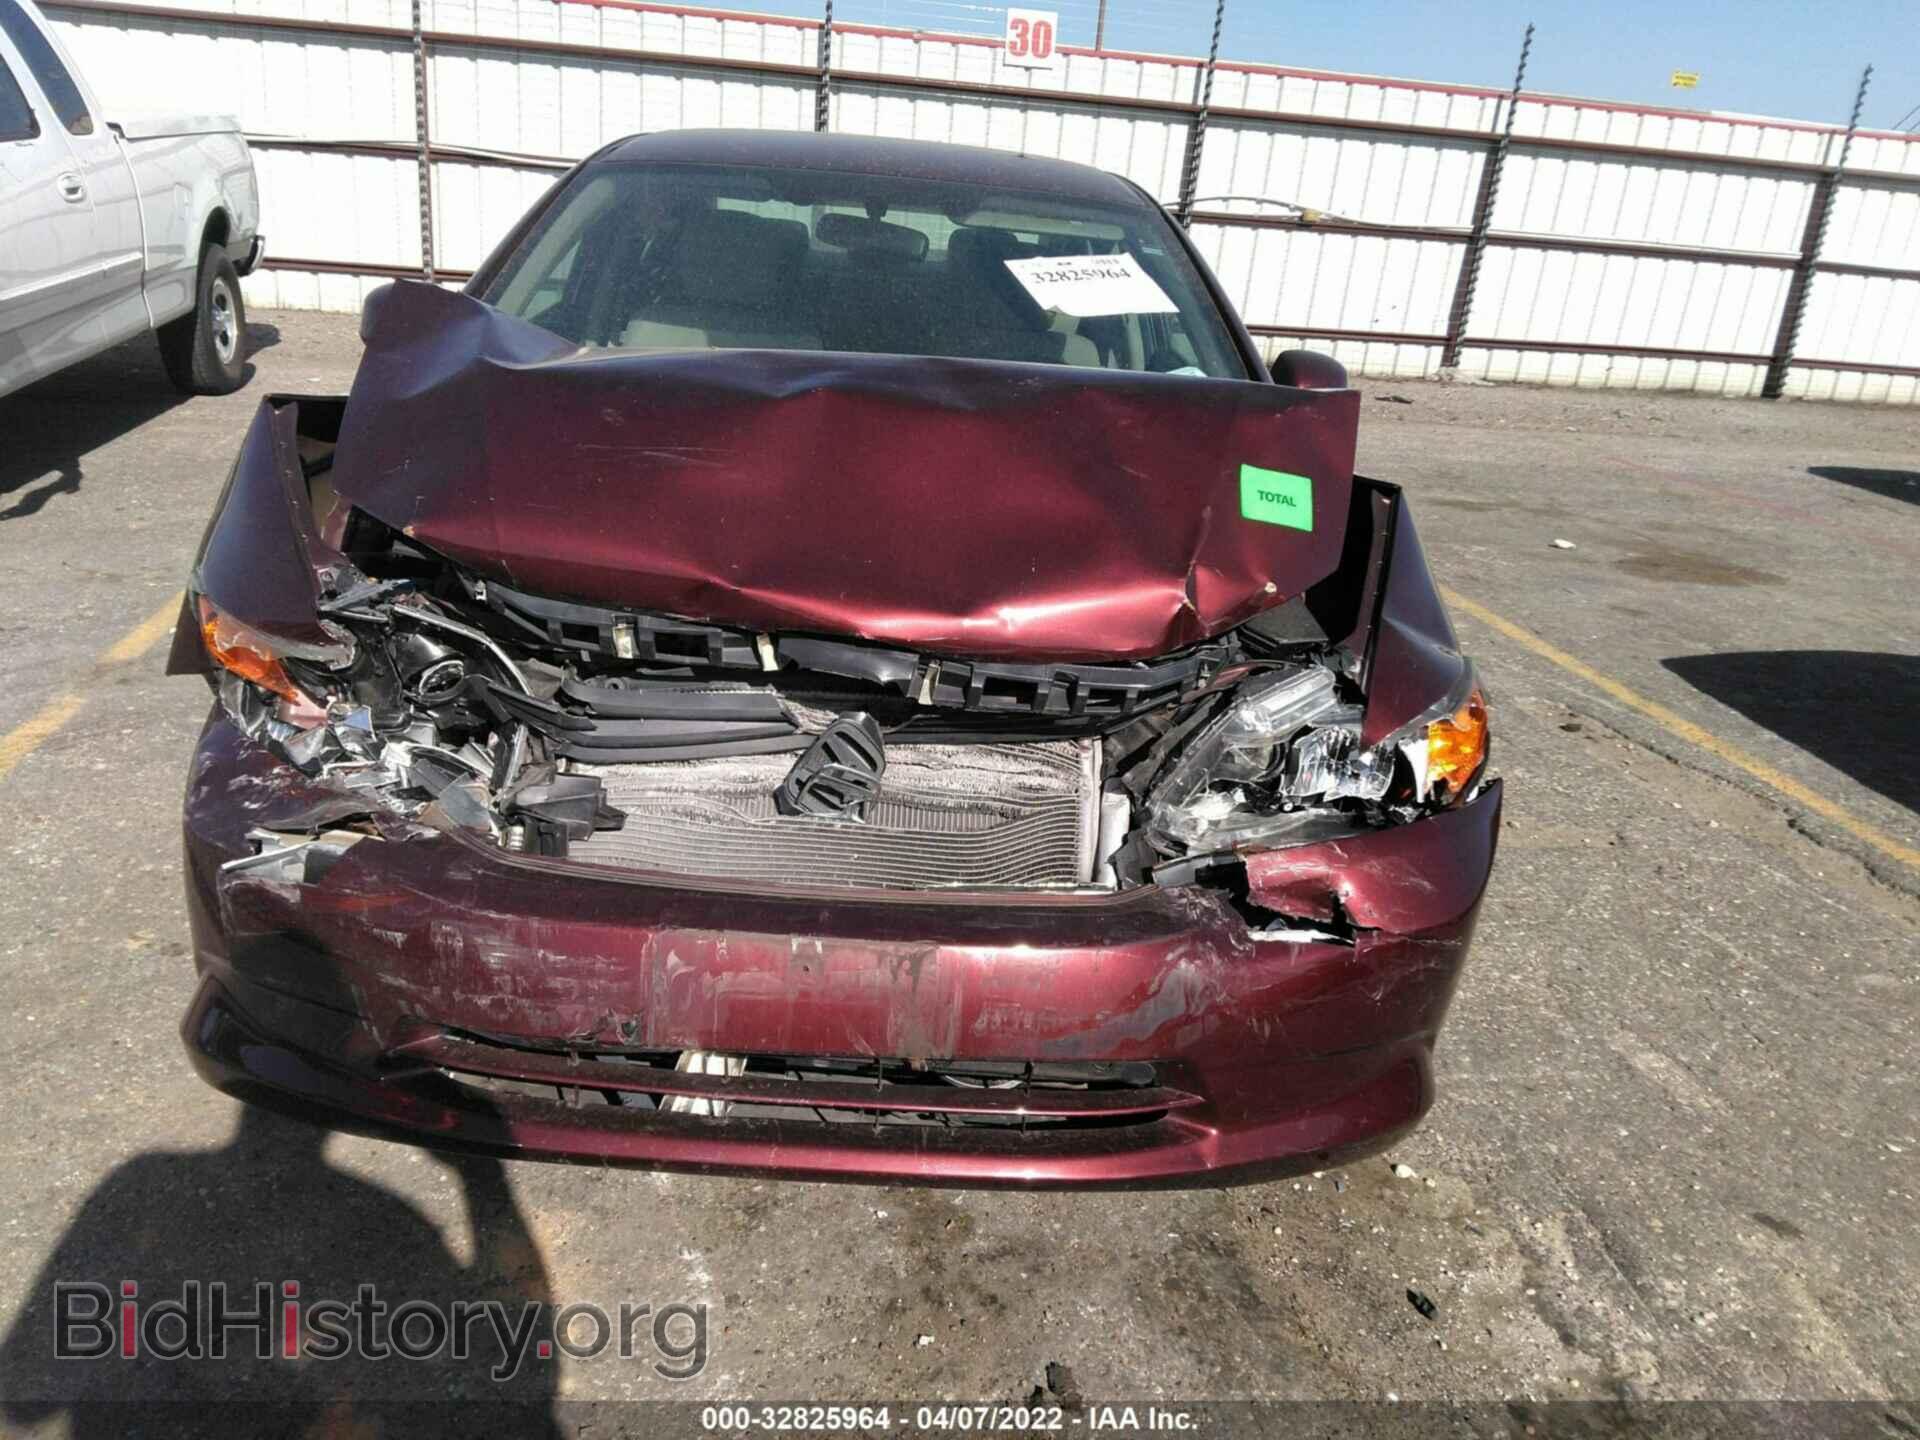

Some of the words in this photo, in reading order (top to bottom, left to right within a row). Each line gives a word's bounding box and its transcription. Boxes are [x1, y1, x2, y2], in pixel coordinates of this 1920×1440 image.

[1009, 17, 1052, 59] 30
[1030, 267, 1131, 285] 32825964
[1257, 489, 1297, 508] TOTAL
